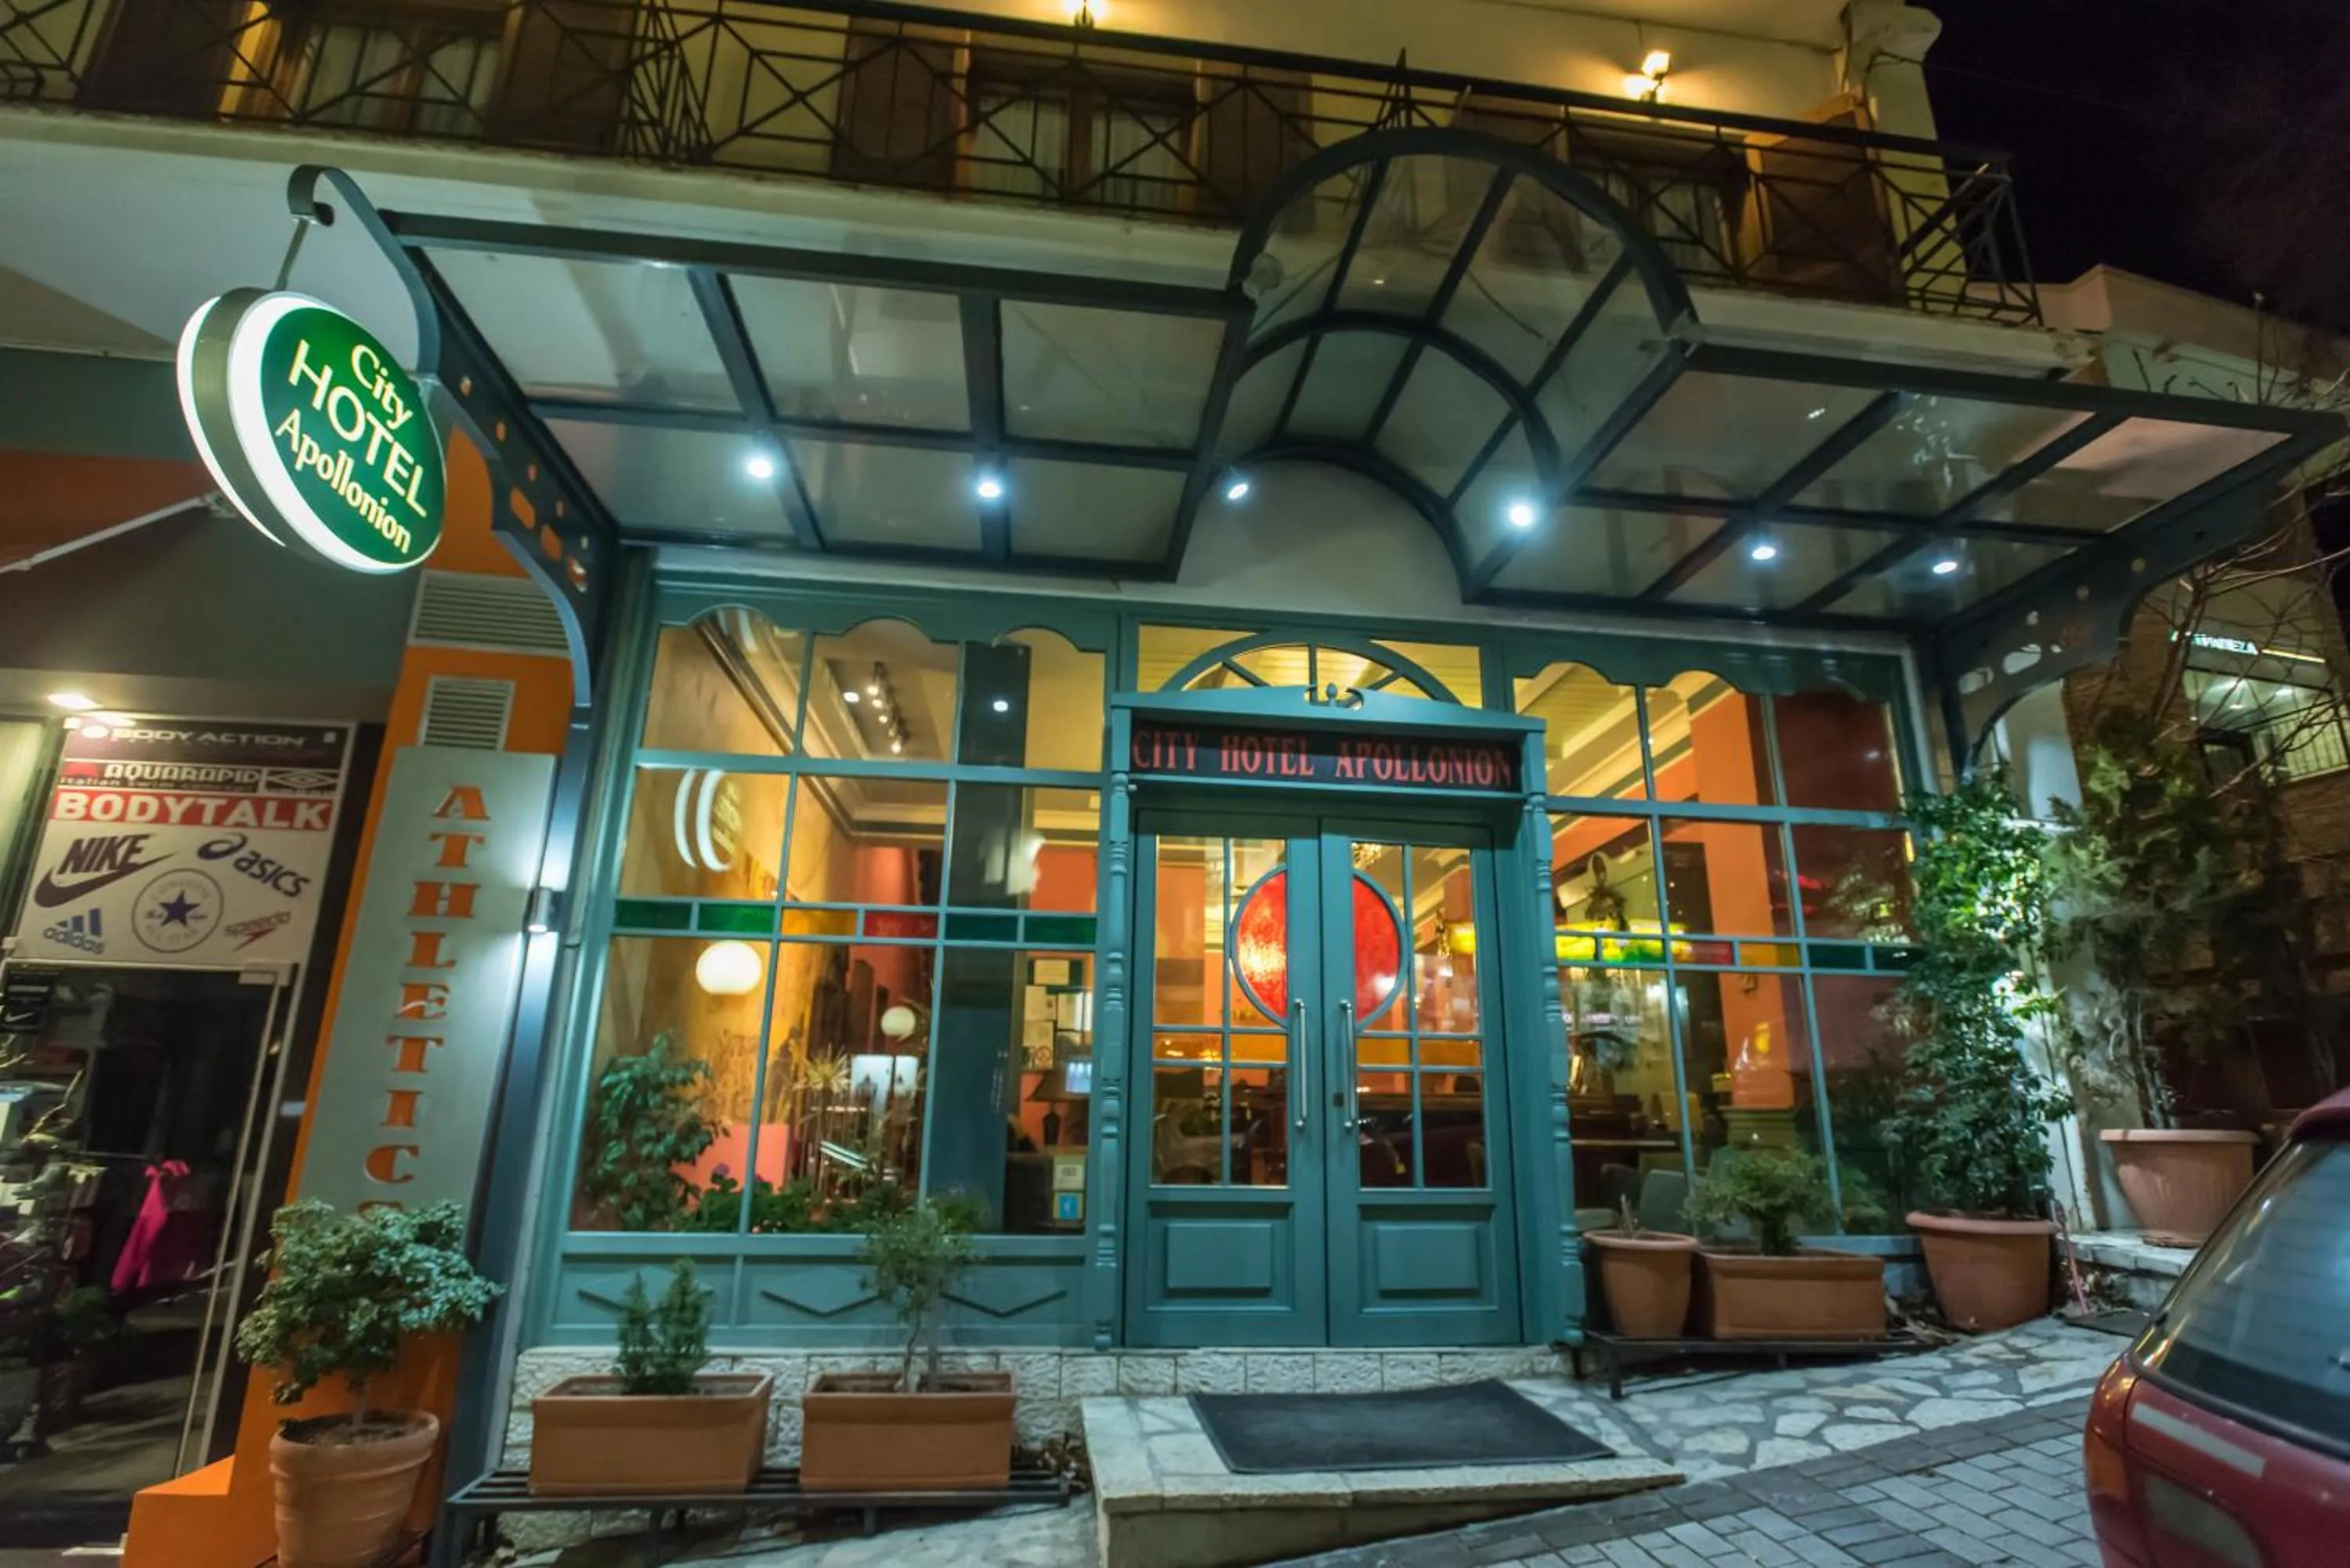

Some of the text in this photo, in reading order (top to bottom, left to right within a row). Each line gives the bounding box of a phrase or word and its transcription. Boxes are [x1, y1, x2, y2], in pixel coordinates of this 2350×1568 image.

[351, 345, 414, 430] City
[288, 339, 428, 518] HOTEL
[276, 408, 412, 554] Apollonion
[111, 728, 193, 742] BODY
[198, 732, 305, 746] ACTION
[1133, 729, 1513, 787] CITY HOTEL APOLLONION
[104, 764, 262, 783] AQUARAPID
[56, 793, 331, 829] BODYTALK
[57, 834, 151, 874] NIKE
[233, 850, 310, 898] asics
[42, 927, 106, 955] adidas
